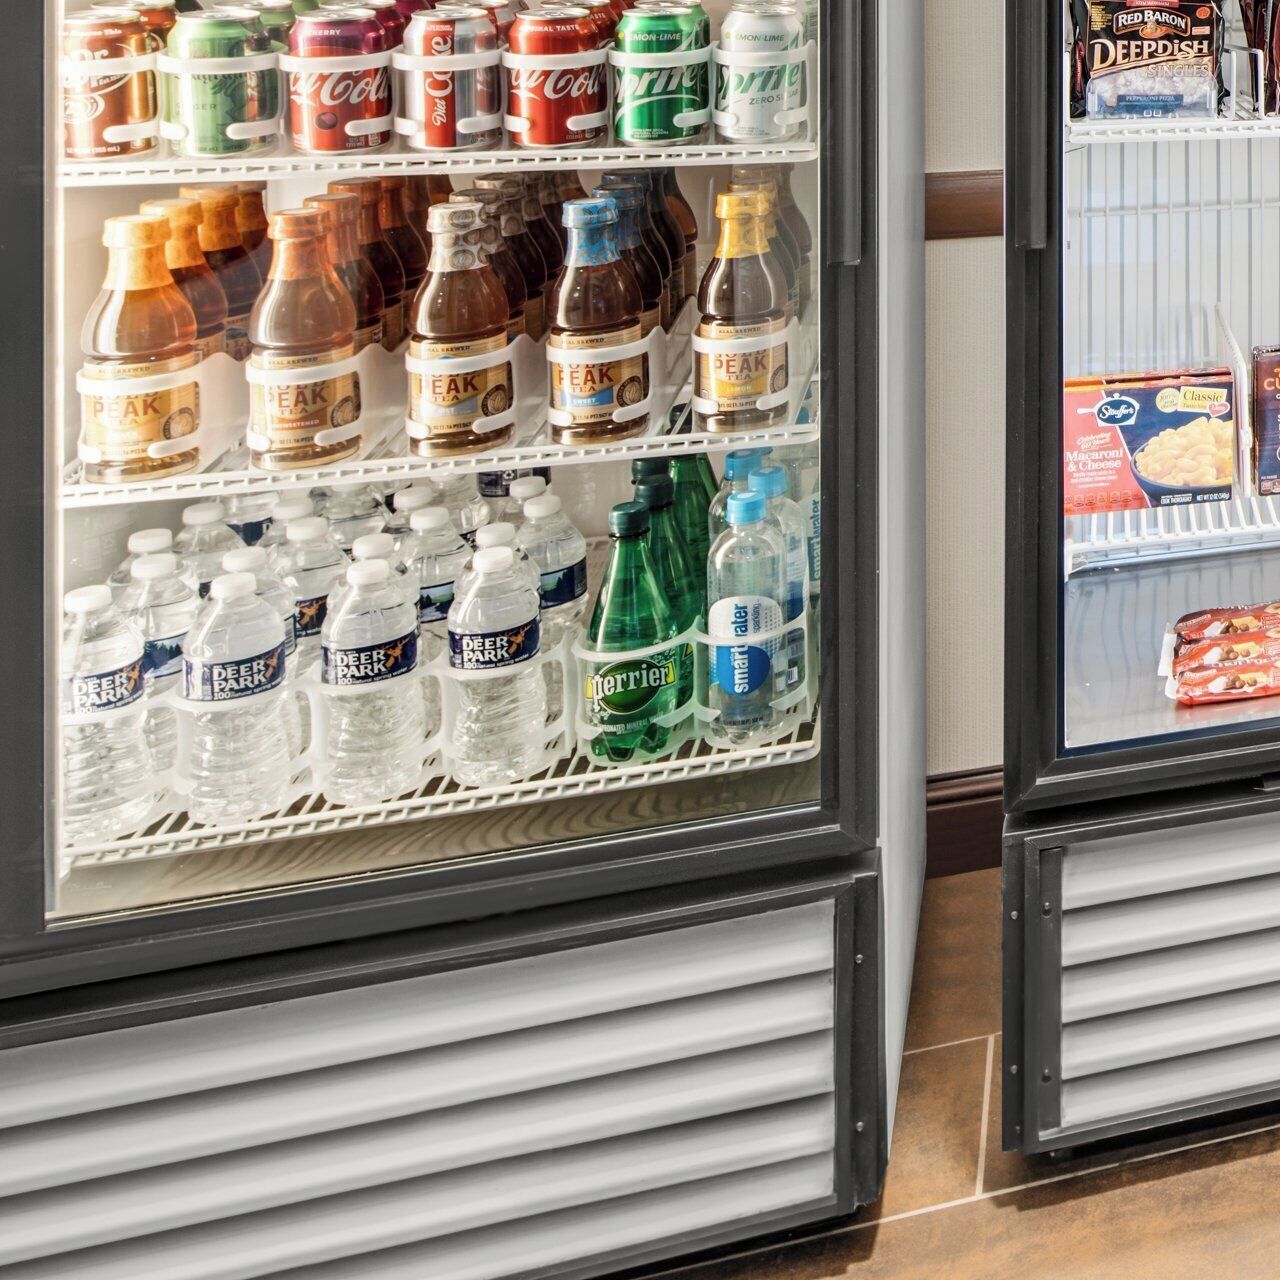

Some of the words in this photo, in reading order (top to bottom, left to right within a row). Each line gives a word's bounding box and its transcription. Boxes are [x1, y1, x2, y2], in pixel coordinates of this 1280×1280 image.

[556, 24, 580, 32] TASTE
[1118, 13, 1143, 26] RED
[1145, 11, 1186, 29] BARON
[308, 29, 341, 37] CHERRY
[1147, 64, 1208, 78] SINGLES
[748, 95, 774, 106] ZERO
[714, 355, 768, 374] PEAK
[558, 366, 614, 386] PEAK
[1183, 390, 1223, 403] Classic
[1066, 448, 1123, 461] Macaroni
[462, 635, 508, 651] DEER
[336, 649, 386, 668] DEER
[462, 647, 511, 662] PARK
[212, 660, 266, 681] DEER
[337, 662, 388, 679] PARK
[73, 671, 128, 694] DEER
[212, 673, 267, 693] PARK
[74, 684, 131, 708] PARK
